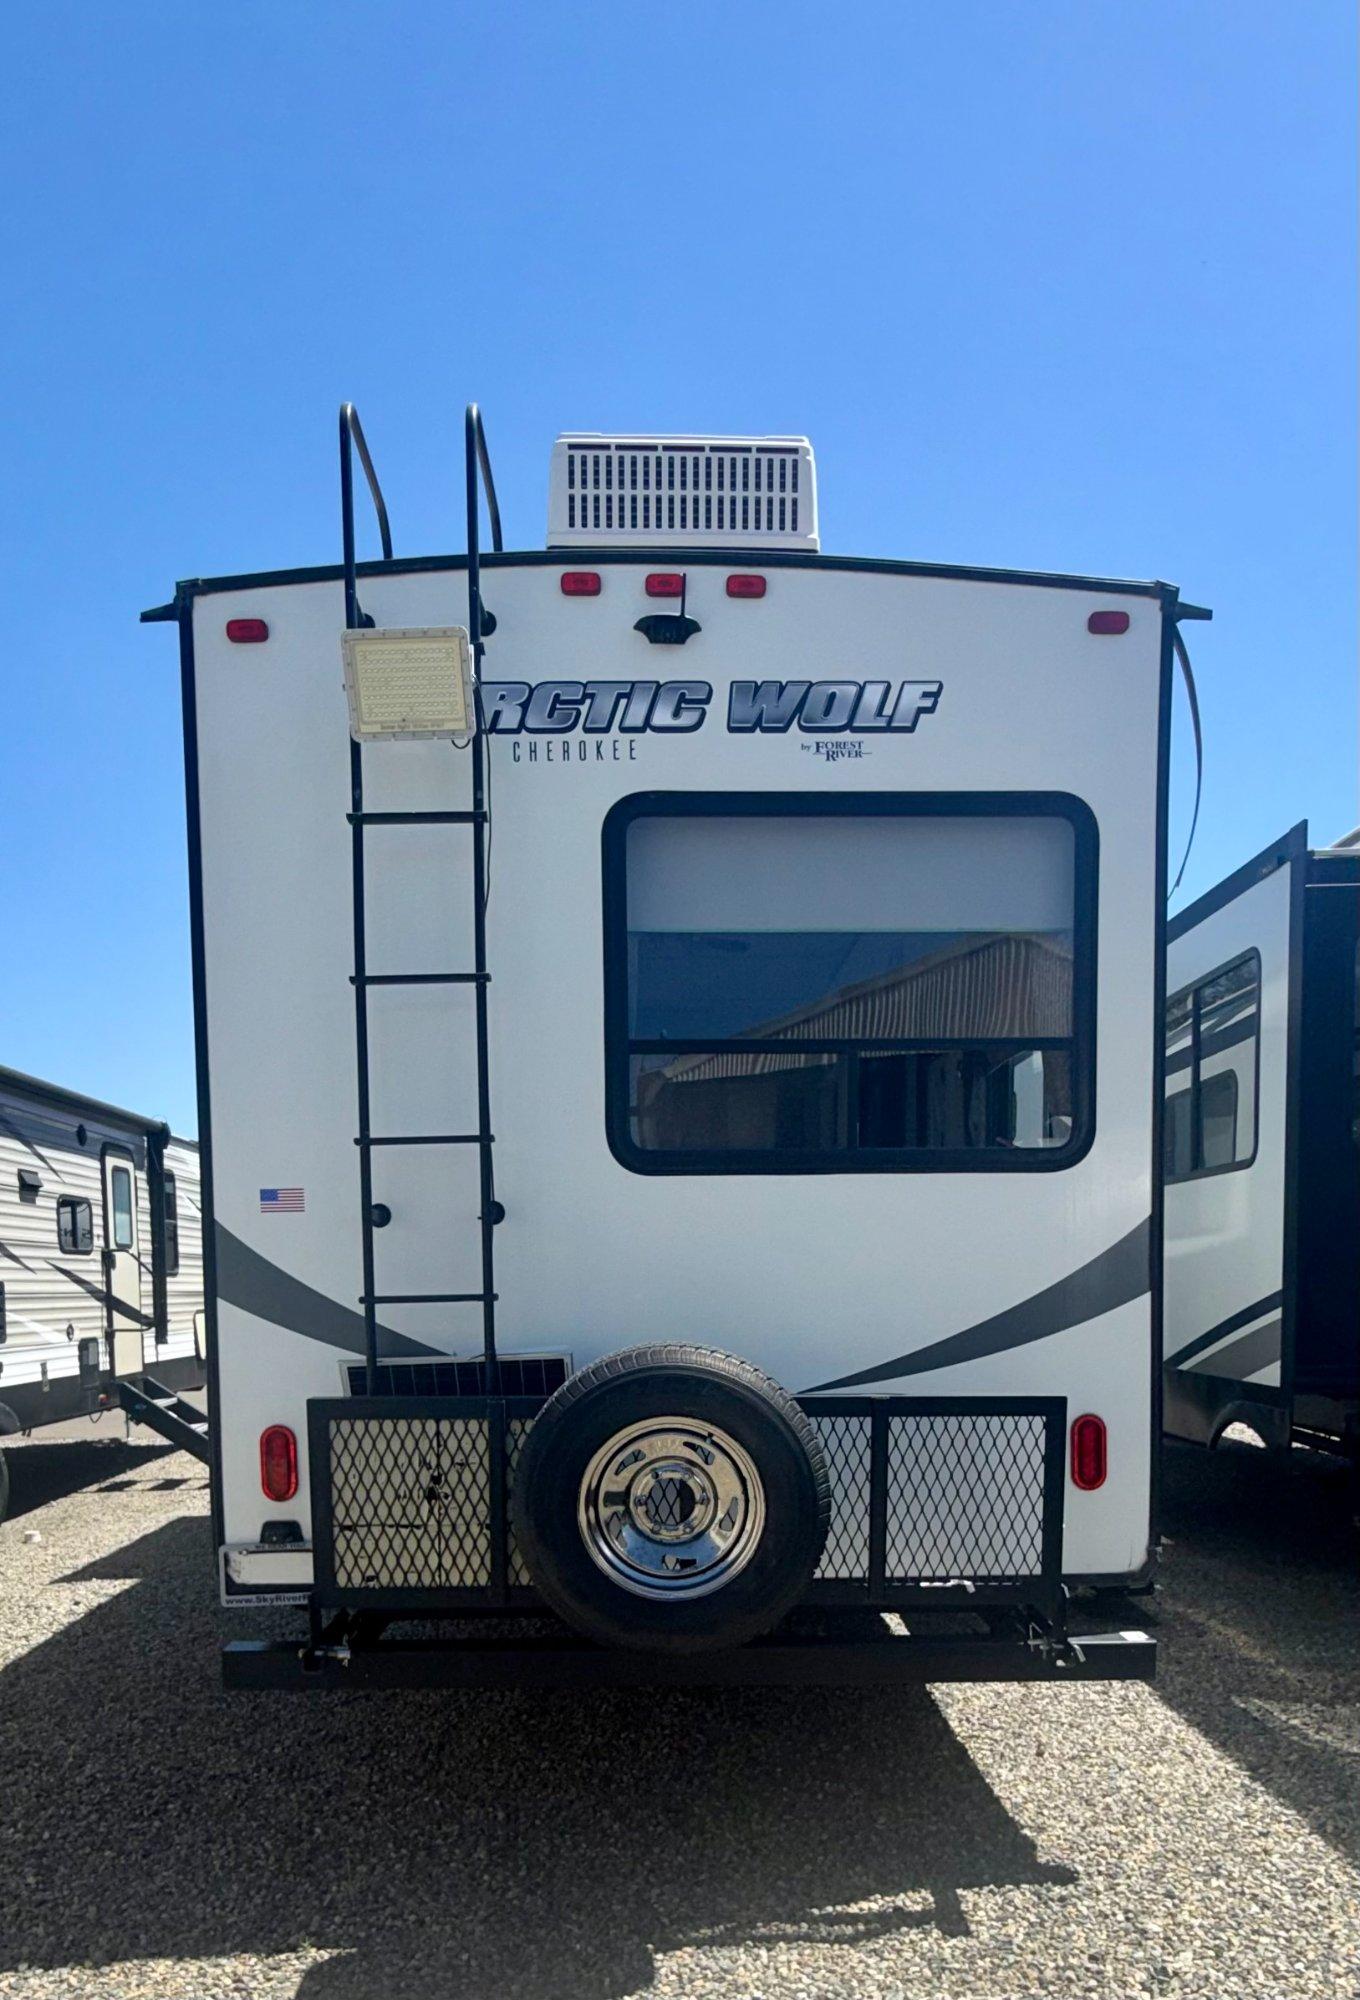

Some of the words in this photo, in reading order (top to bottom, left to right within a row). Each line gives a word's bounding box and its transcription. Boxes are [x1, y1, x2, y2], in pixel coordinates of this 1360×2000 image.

[479, 680, 713, 733] RCTIC
[727, 680, 943, 733] WOLF
[512, 739, 636, 762] CHEROKEE
[801, 743, 811, 752] by
[815, 741, 863, 754] FOREST
[825, 750, 863, 762] RIVER
